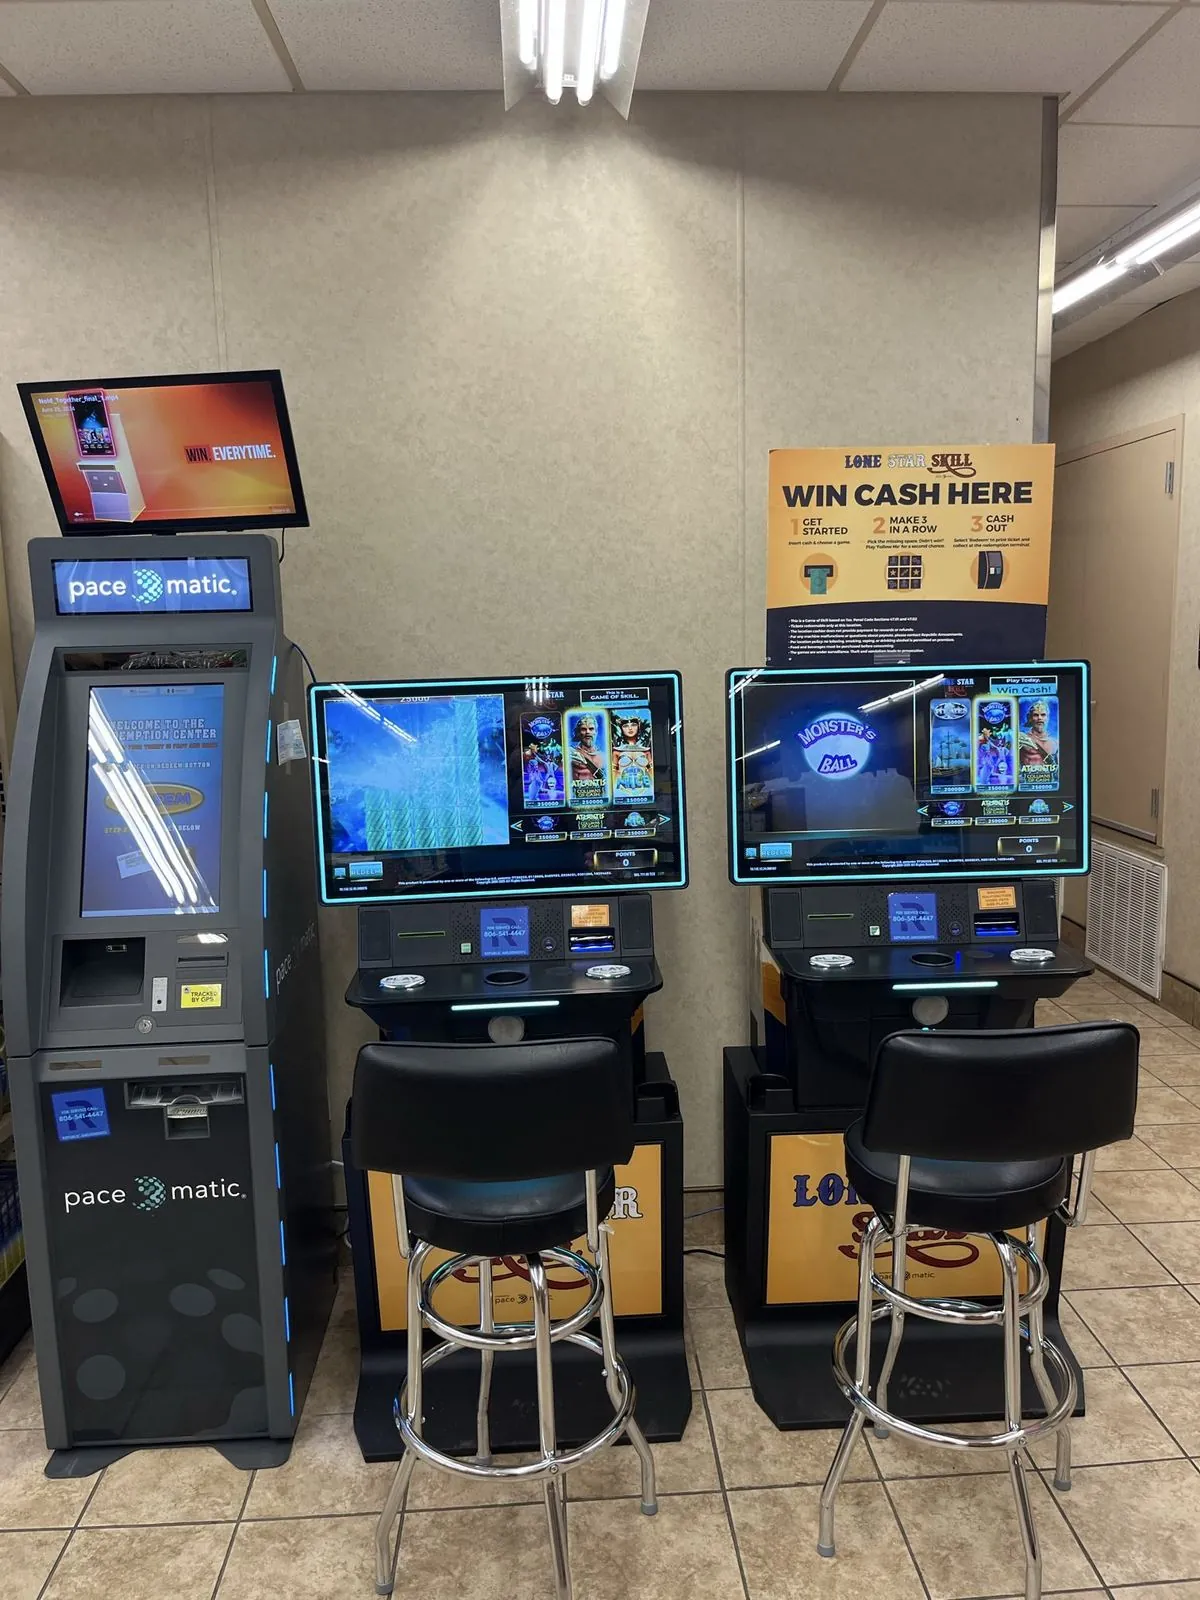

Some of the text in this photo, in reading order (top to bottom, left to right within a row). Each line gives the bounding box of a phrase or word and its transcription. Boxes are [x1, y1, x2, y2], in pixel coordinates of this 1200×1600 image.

[185, 444, 276, 462] WIN. EVERYTIME.
[844, 453, 977, 478] LONE STAR SKILL
[782, 481, 1033, 508] WIN CASH HERE
[790, 518, 799, 536] 1
[802, 518, 823, 526] GET
[873, 517, 886, 534] 2
[889, 516, 927, 525] MAKE 3
[971, 515, 983, 532] 3
[986, 515, 1014, 523] CASH
[802, 527, 848, 536] STARTED
[889, 526, 900, 534] IN
[912, 525, 938, 534] ROW
[986, 524, 1007, 532] OUT
[69, 580, 126, 604] pace
[165, 719, 179, 729] TO
[182, 718, 205, 729] THE
[173, 729, 217, 740] CENTER
[798, 720, 876, 745] MONSTER'S
[820, 757, 856, 773] BALL
[1026, 845, 1032, 853] 0
[623, 859, 629, 867] 0
[900, 902, 927, 931] R
[484, 930, 526, 938] 806-541-4447
[492, 917, 518, 947] R
[59, 1110, 104, 1122] 806-541-4447
[65, 1100, 98, 1131] R
[64, 1189, 126, 1213] pace
